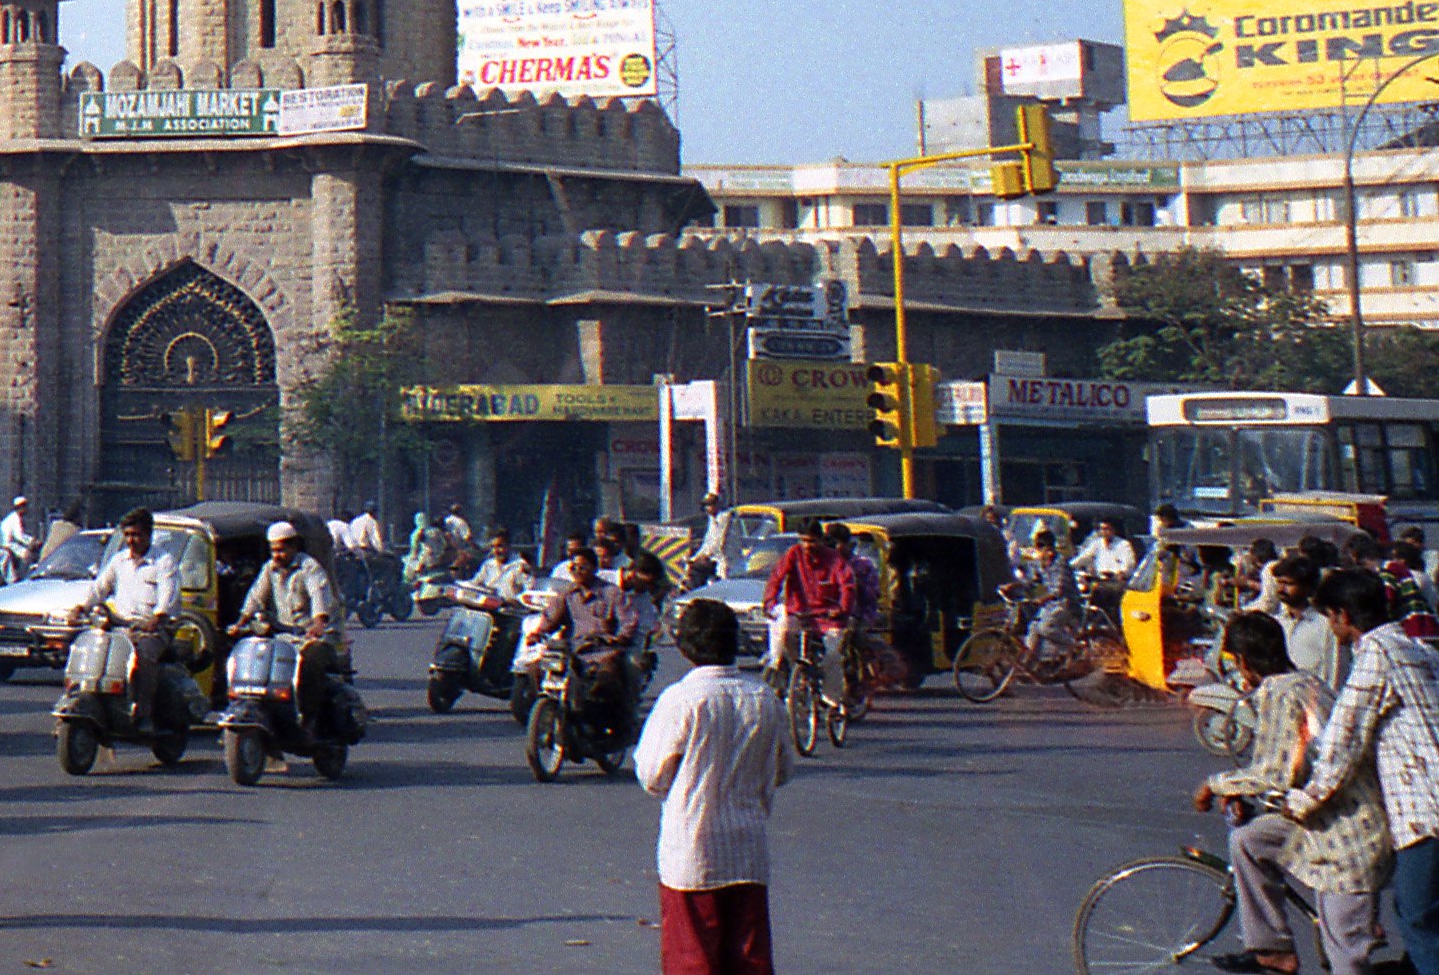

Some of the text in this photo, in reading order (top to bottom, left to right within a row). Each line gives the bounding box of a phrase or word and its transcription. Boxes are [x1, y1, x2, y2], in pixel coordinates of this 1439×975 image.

[517, 37, 540, 47] New
[1235, 29, 1439, 68] KING
[195, 91, 261, 117] MARKET
[163, 118, 252, 132] ASSOCIATION
[792, 367, 868, 389] CROW
[1008, 378, 1131, 408] METALICO
[812, 407, 875, 425] ENTERP
